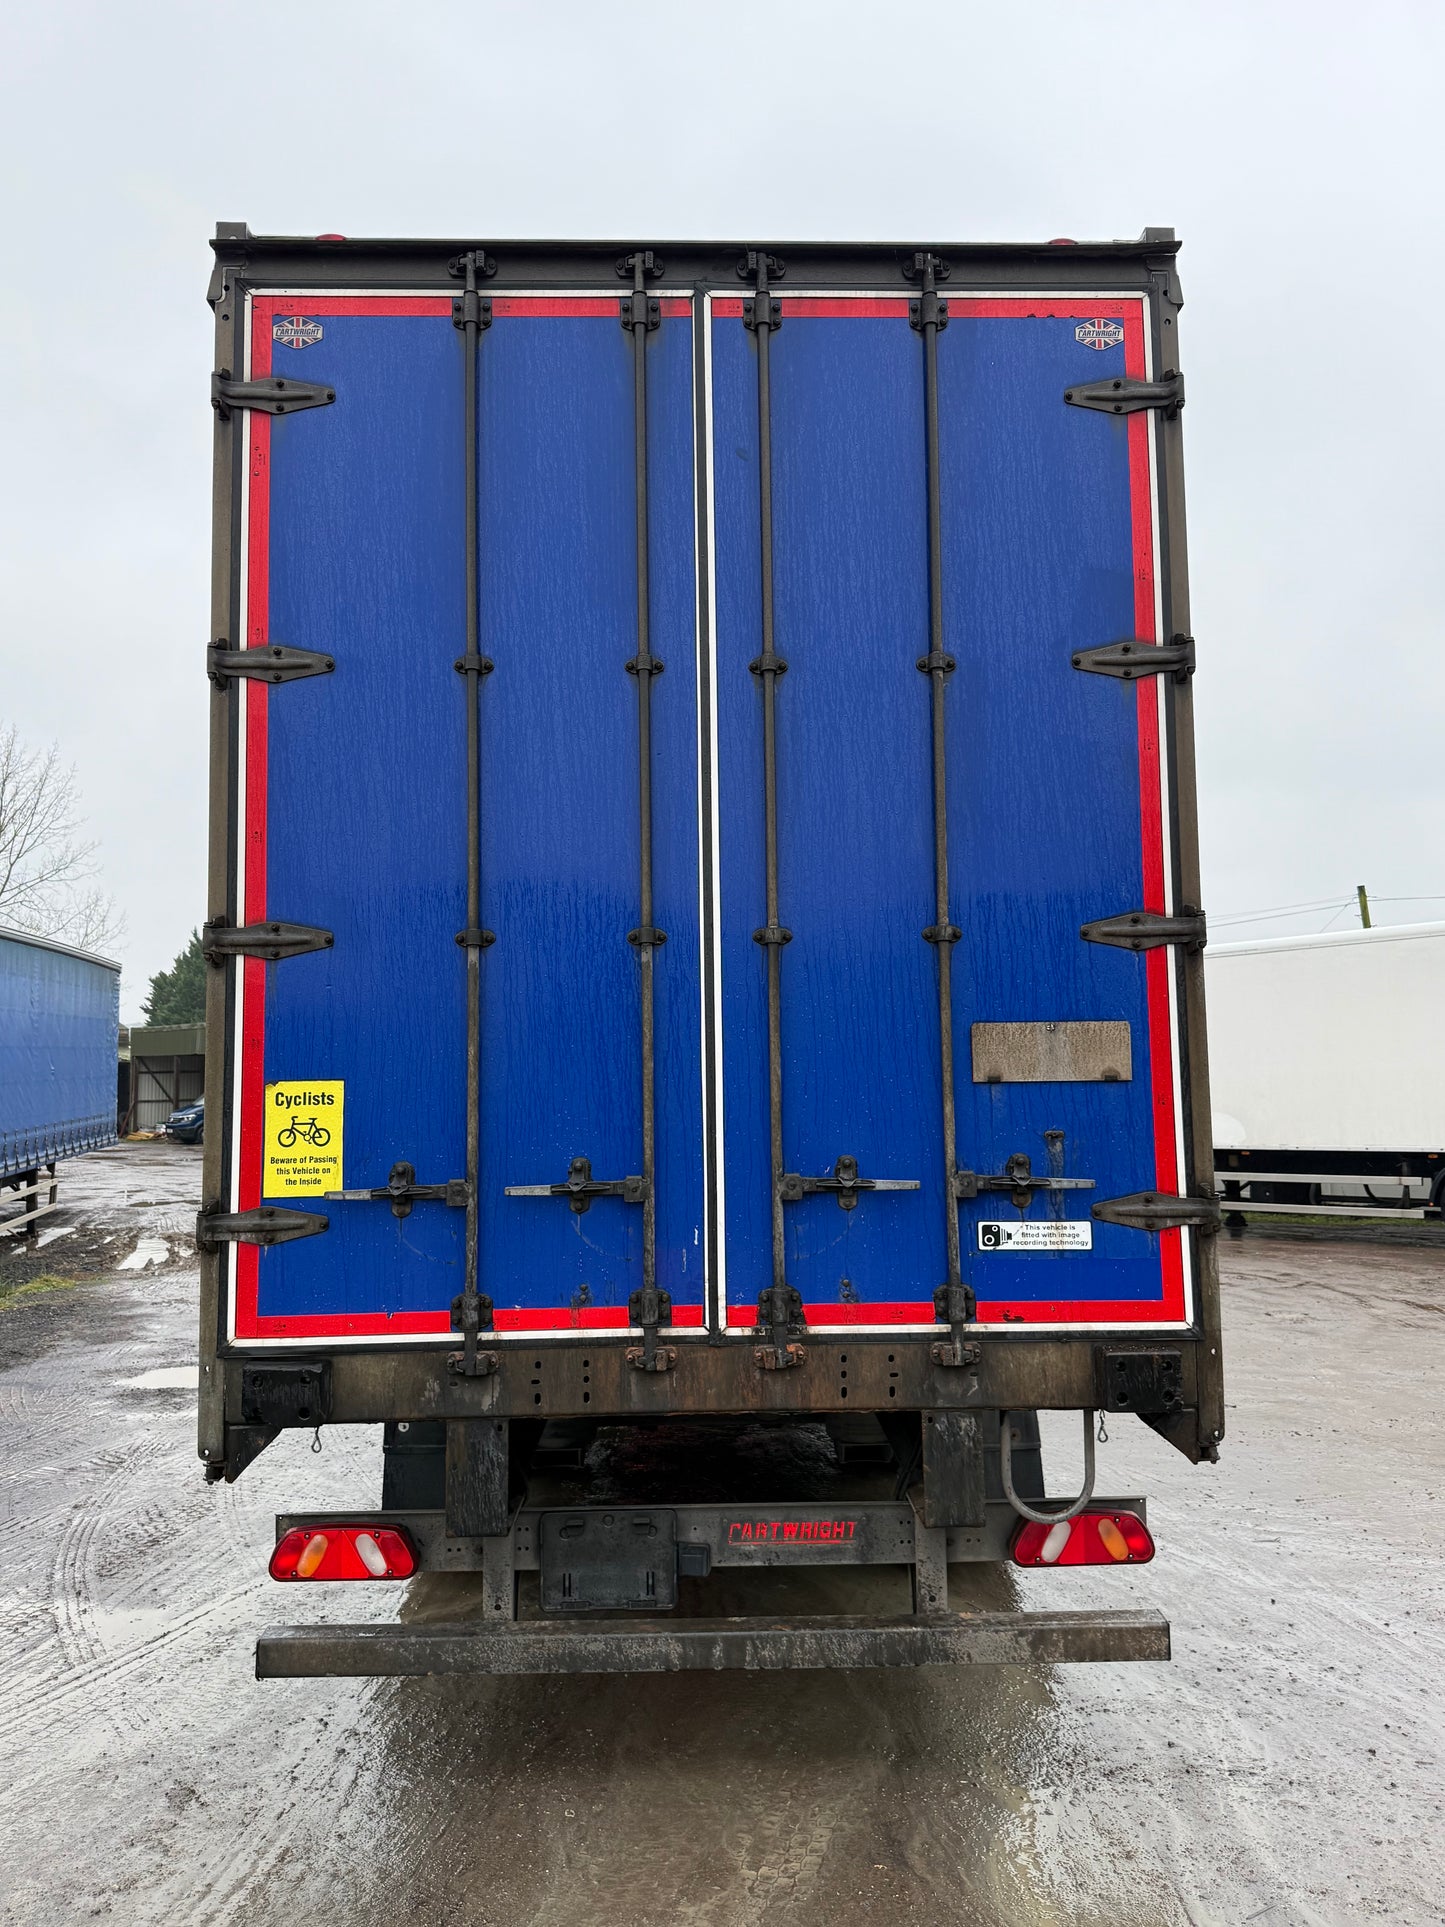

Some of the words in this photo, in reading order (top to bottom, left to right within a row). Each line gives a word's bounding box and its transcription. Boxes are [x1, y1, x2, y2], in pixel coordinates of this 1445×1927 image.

[275, 328, 321, 336] CARTWRIGHT
[275, 1092, 335, 1109] Cyclists
[300, 1156, 307, 1164] of
[309, 1156, 337, 1164] Passing
[292, 1167, 320, 1175] Vehicle
[285, 1178, 298, 1186] the
[300, 1178, 322, 1186] Inside
[728, 1521, 858, 1543] CARTWRIGHT
